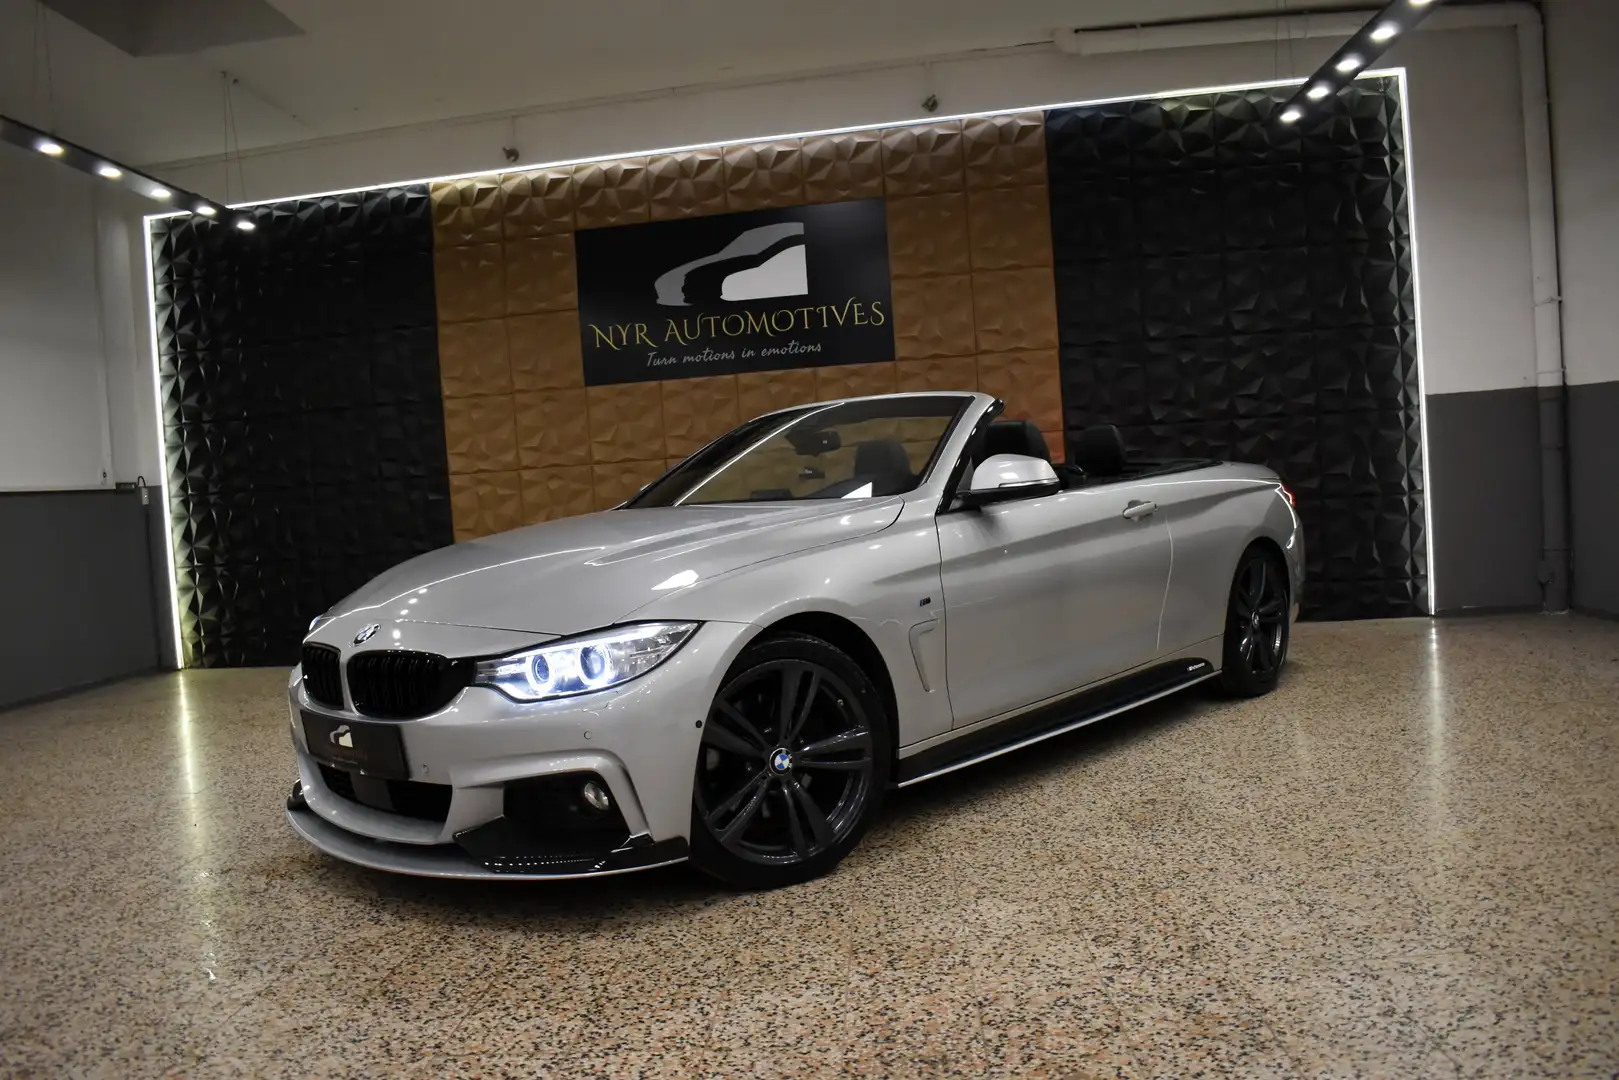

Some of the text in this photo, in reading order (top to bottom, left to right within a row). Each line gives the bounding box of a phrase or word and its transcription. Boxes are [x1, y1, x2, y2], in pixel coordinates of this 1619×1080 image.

[589, 297, 886, 350] NYR AUTOMOTIVES
[646, 340, 823, 367] Turn motions in emotions
